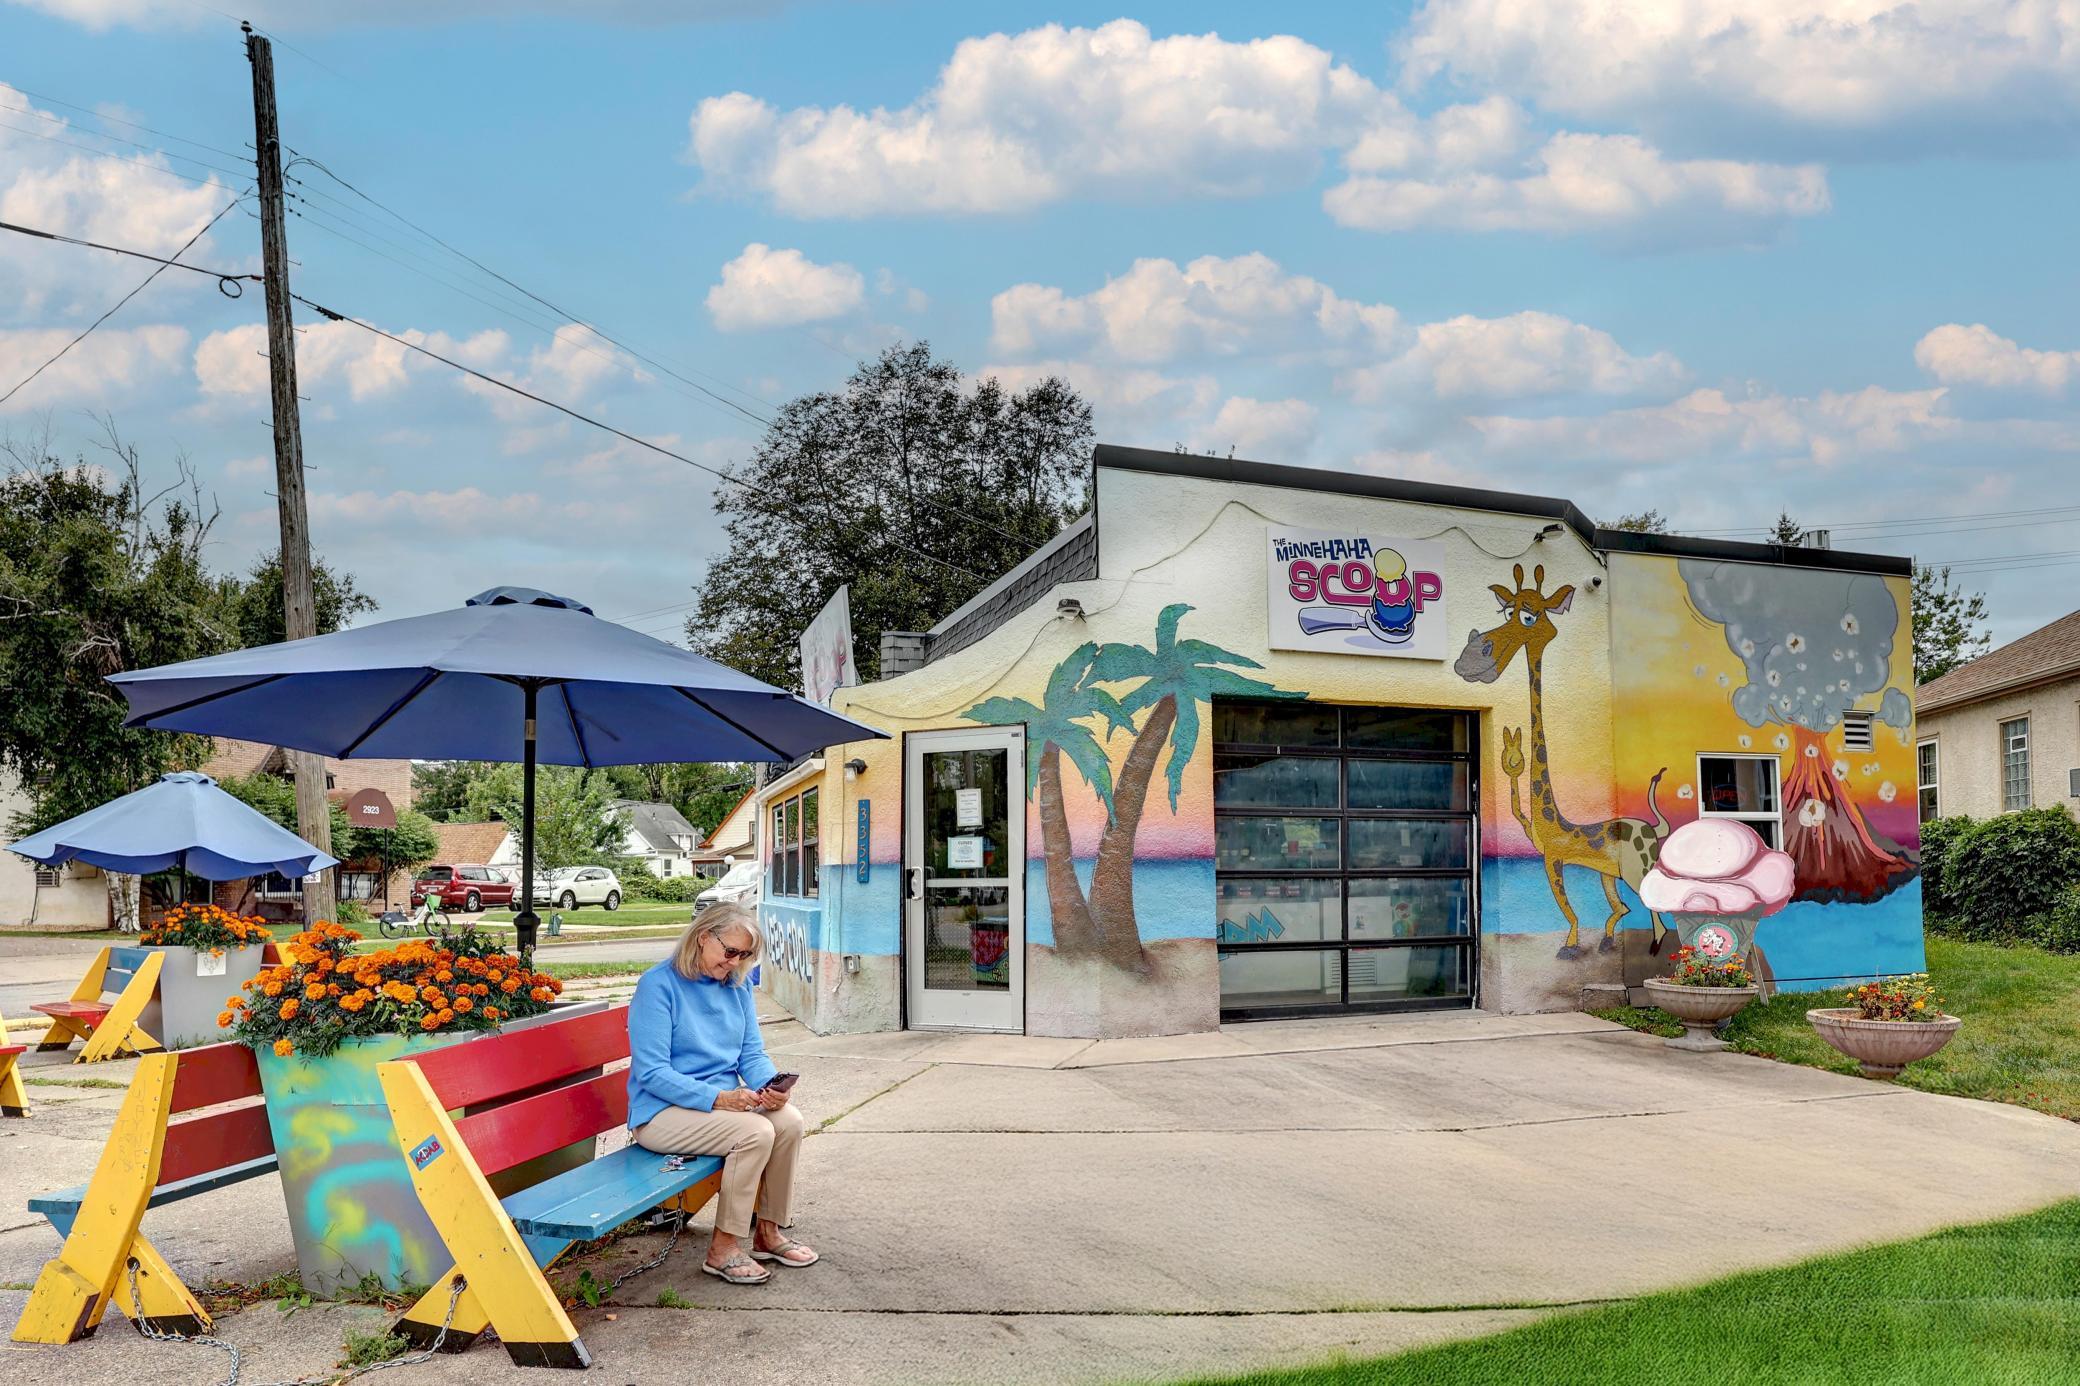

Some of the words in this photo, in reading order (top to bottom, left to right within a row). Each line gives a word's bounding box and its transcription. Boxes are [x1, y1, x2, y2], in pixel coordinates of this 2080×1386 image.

[1272, 538, 1286, 547] THE
[1289, 559, 1443, 613] SCOOP
[362, 805, 380, 815] 2923
[1712, 788, 1749, 801] OPEN
[859, 807, 868, 875] 3352
[786, 918, 812, 983] COOL
